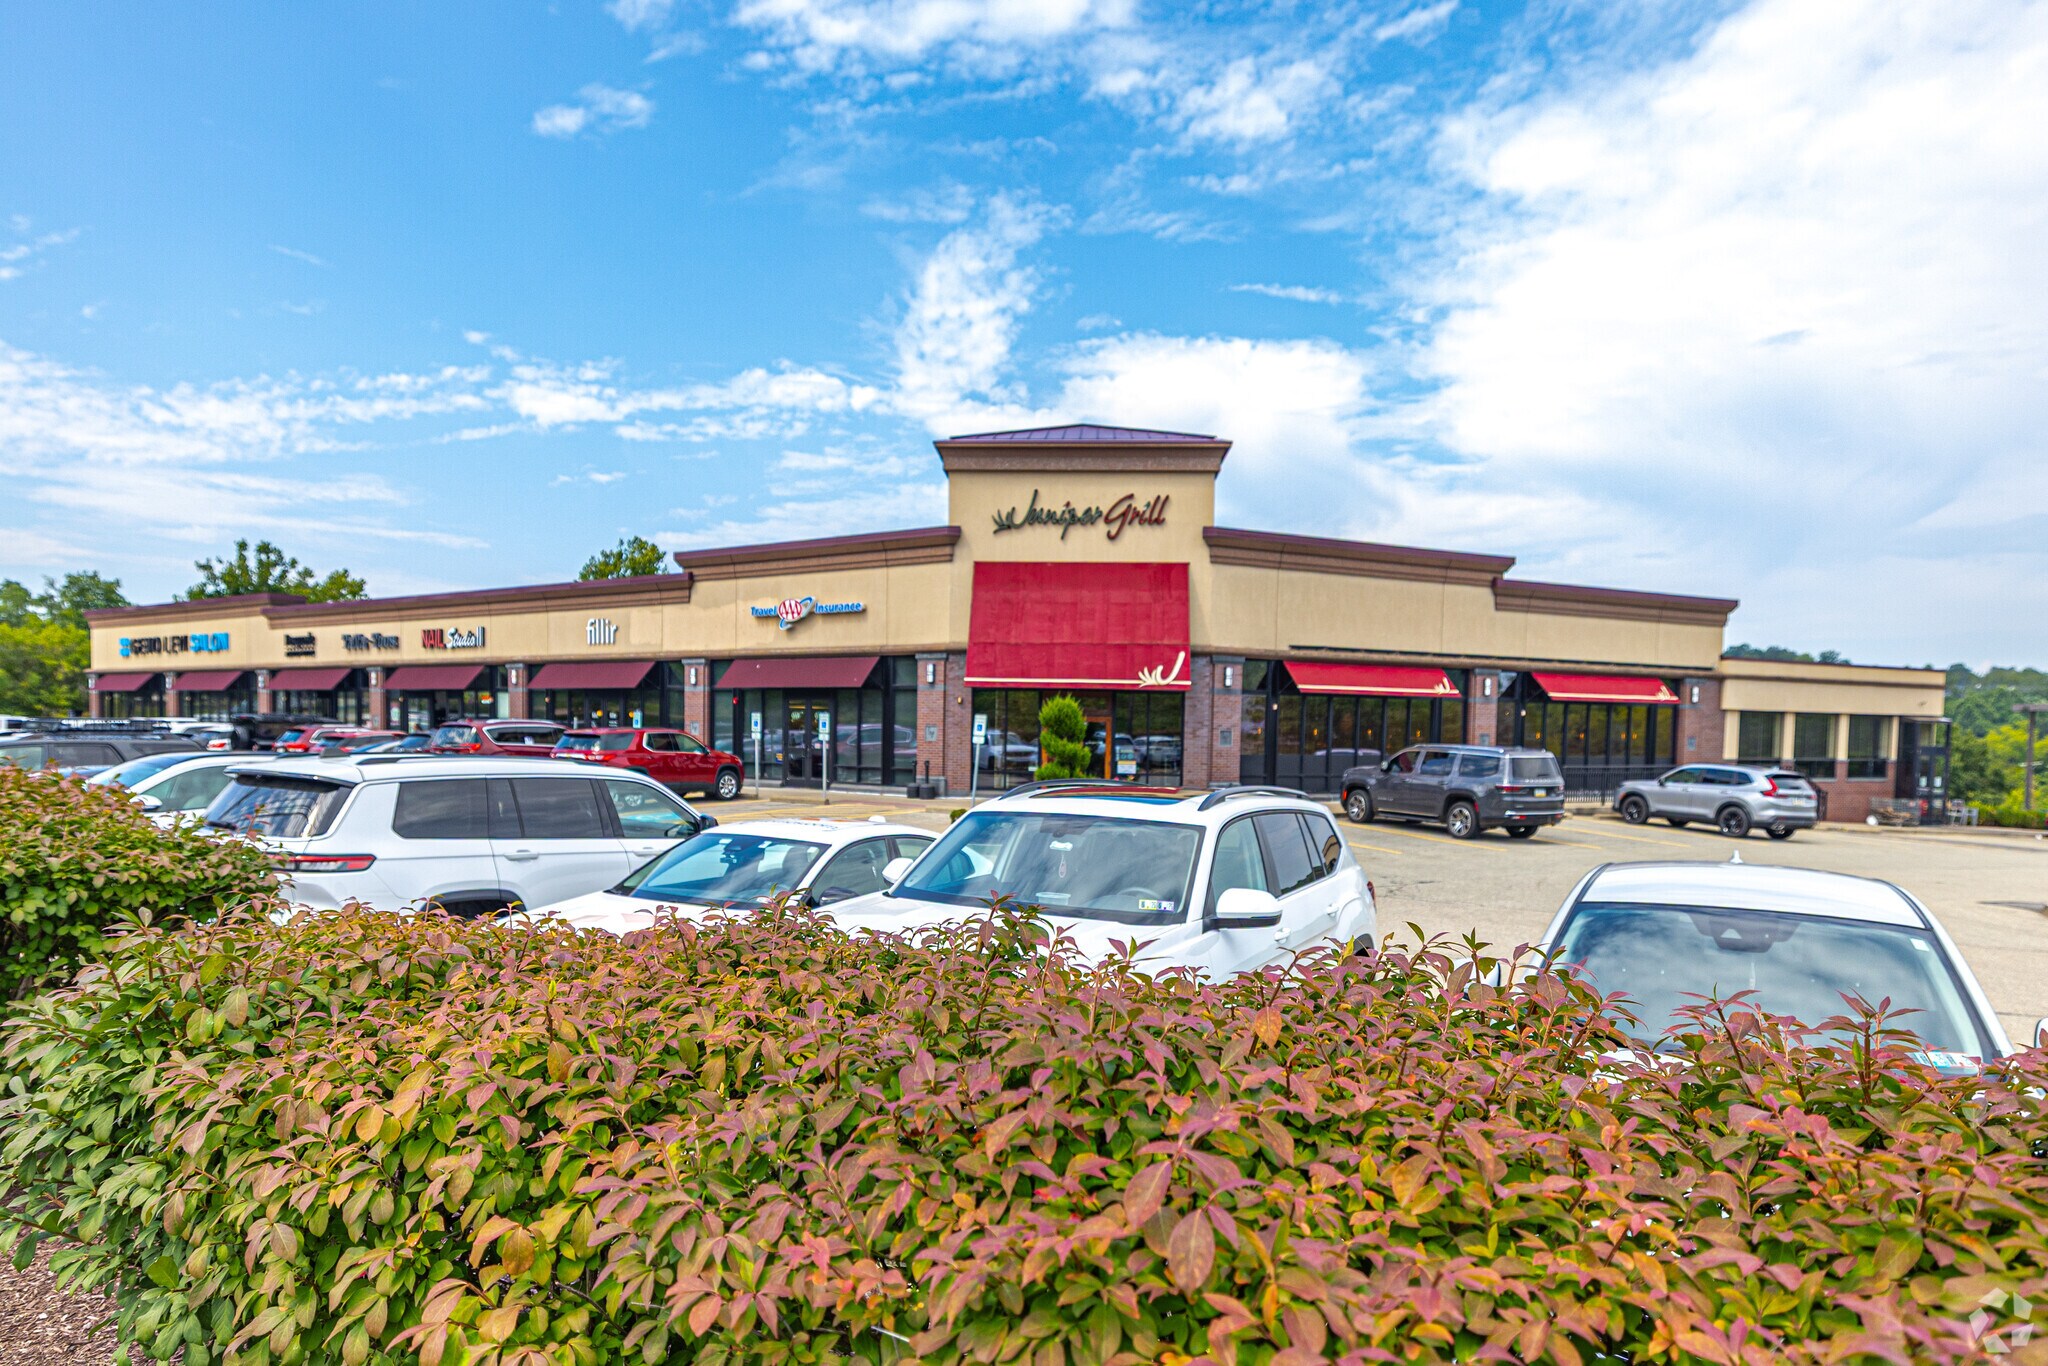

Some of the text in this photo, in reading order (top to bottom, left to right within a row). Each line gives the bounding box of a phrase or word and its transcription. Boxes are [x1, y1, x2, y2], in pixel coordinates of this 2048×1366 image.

[1004, 488, 1170, 541] Juniper Grill
[750, 598, 864, 622] Travel AAA Insurance
[421, 628, 445, 649] NAIL
[445, 626, 477, 649] Studio
